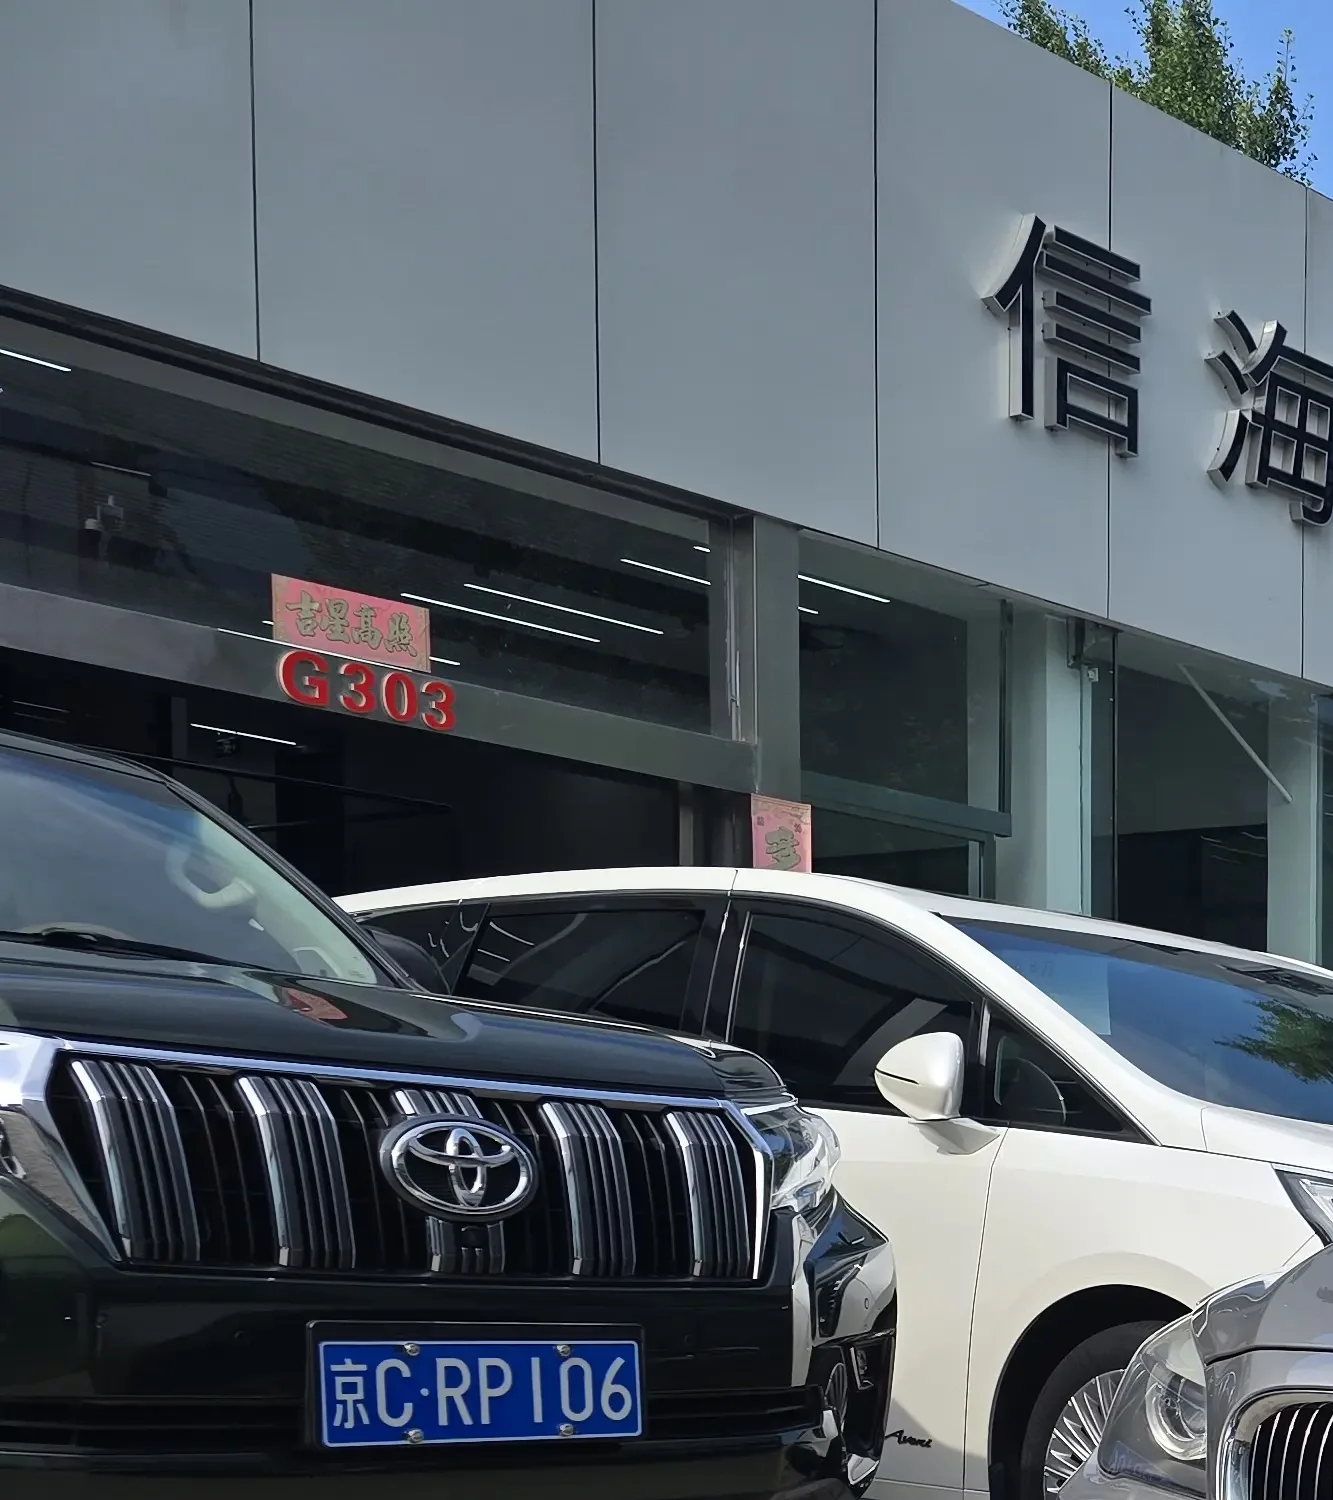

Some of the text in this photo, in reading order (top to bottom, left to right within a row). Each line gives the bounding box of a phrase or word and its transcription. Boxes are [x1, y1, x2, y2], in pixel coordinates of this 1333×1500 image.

[286, 590, 418, 657] 吉星高照
[278, 650, 456, 731] G303
